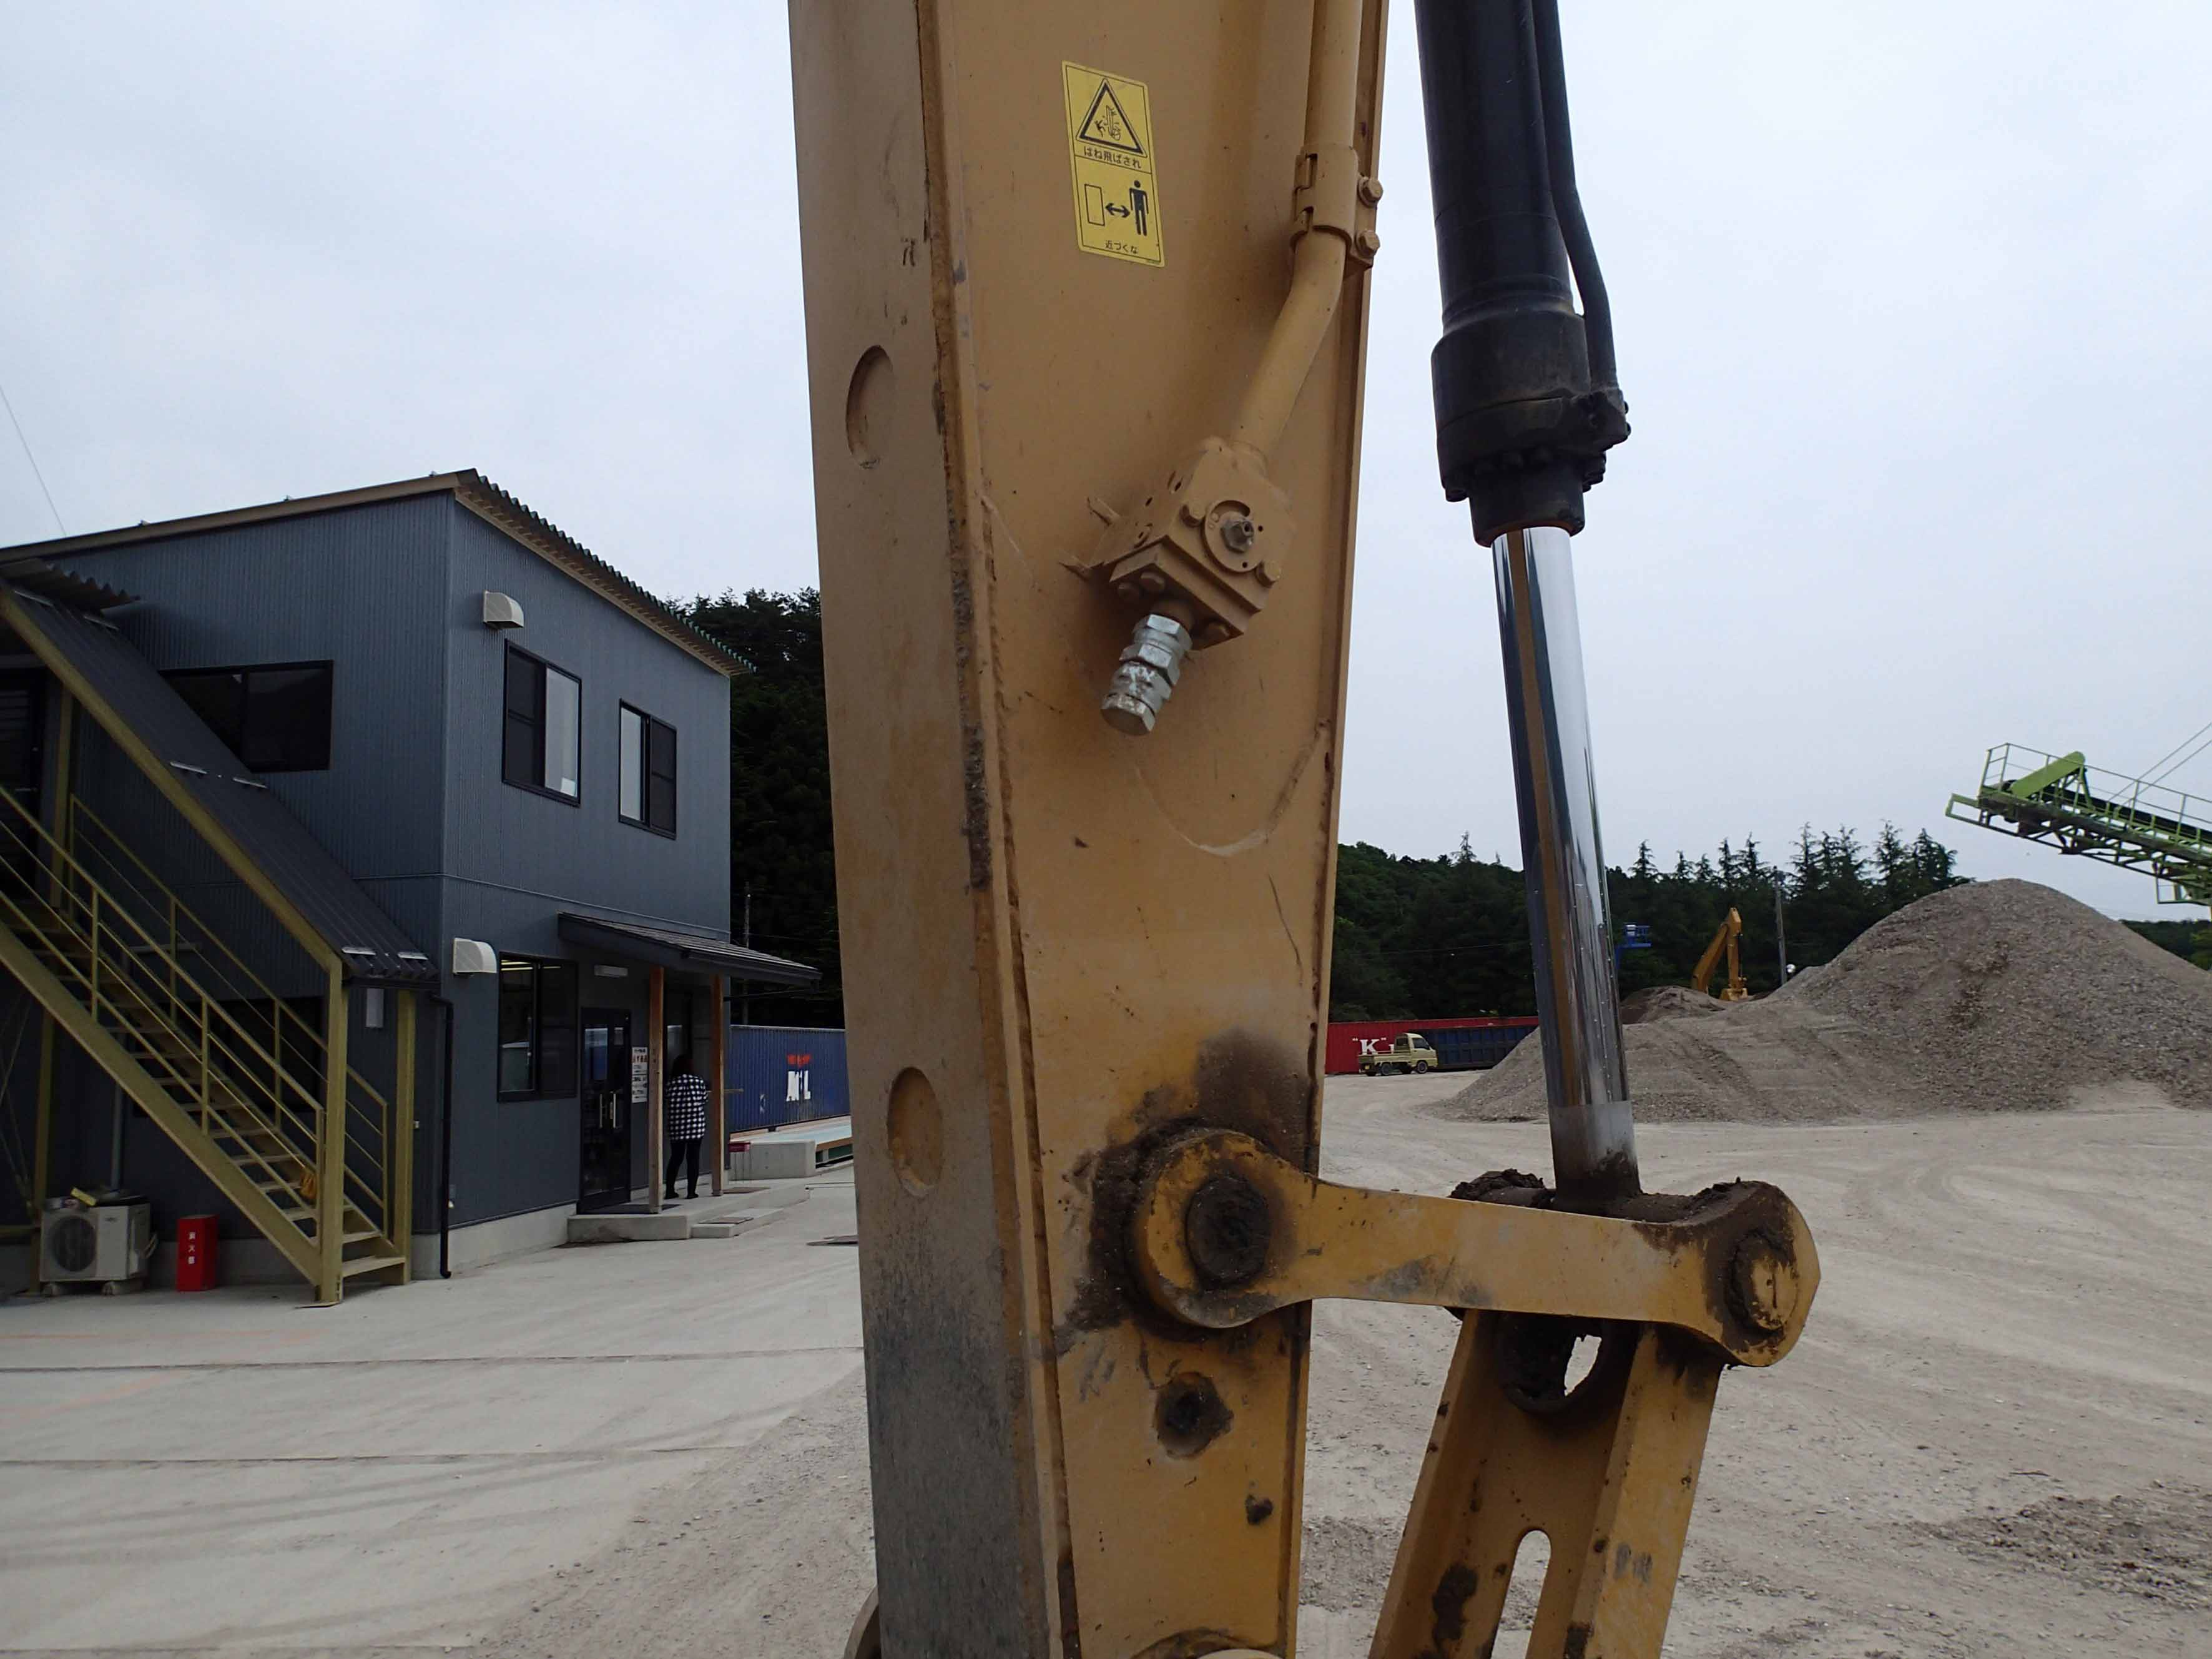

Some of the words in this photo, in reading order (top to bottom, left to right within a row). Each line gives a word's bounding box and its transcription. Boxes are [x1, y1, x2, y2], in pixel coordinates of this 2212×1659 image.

[1083, 145, 1142, 169] はね飛ばされ
[1104, 240, 1139, 254] 近づくな
